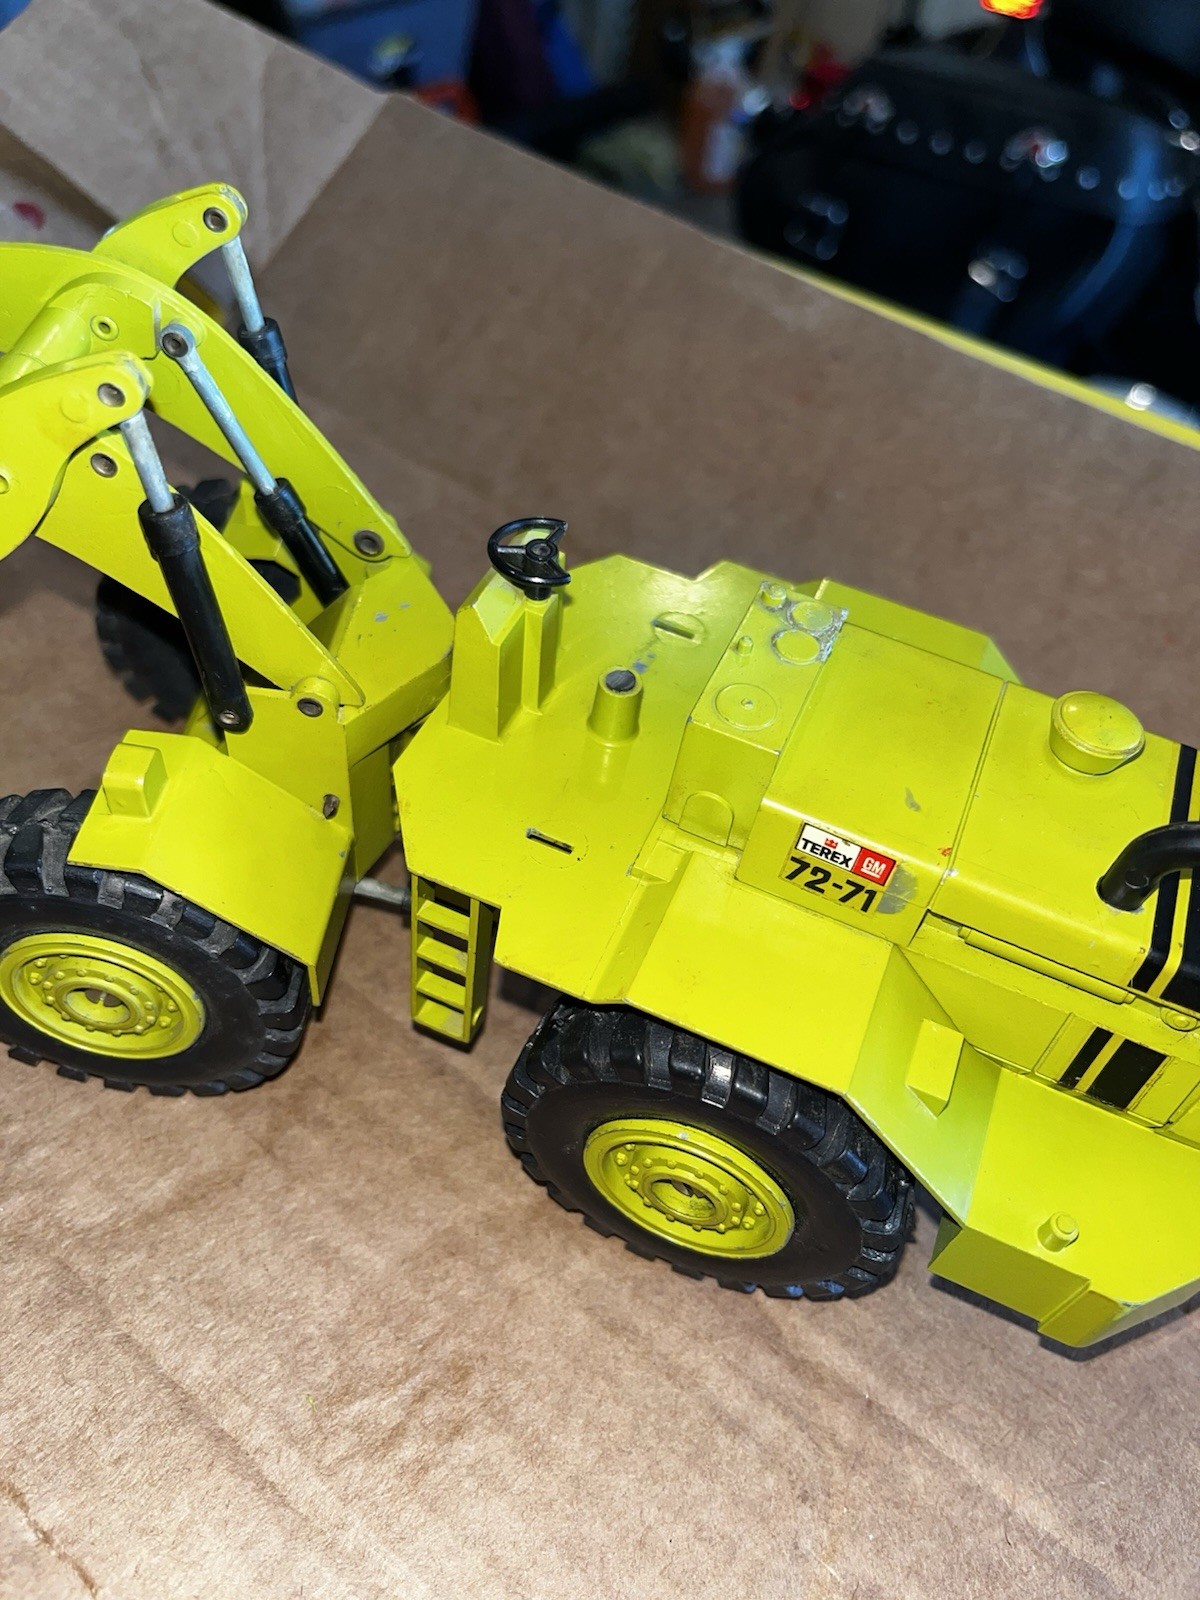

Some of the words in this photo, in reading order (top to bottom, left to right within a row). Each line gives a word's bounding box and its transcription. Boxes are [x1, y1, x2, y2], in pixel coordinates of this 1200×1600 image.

[802, 838, 853, 868] TEREX
[862, 857, 886, 876] GM
[785, 855, 877, 913] 72-71
